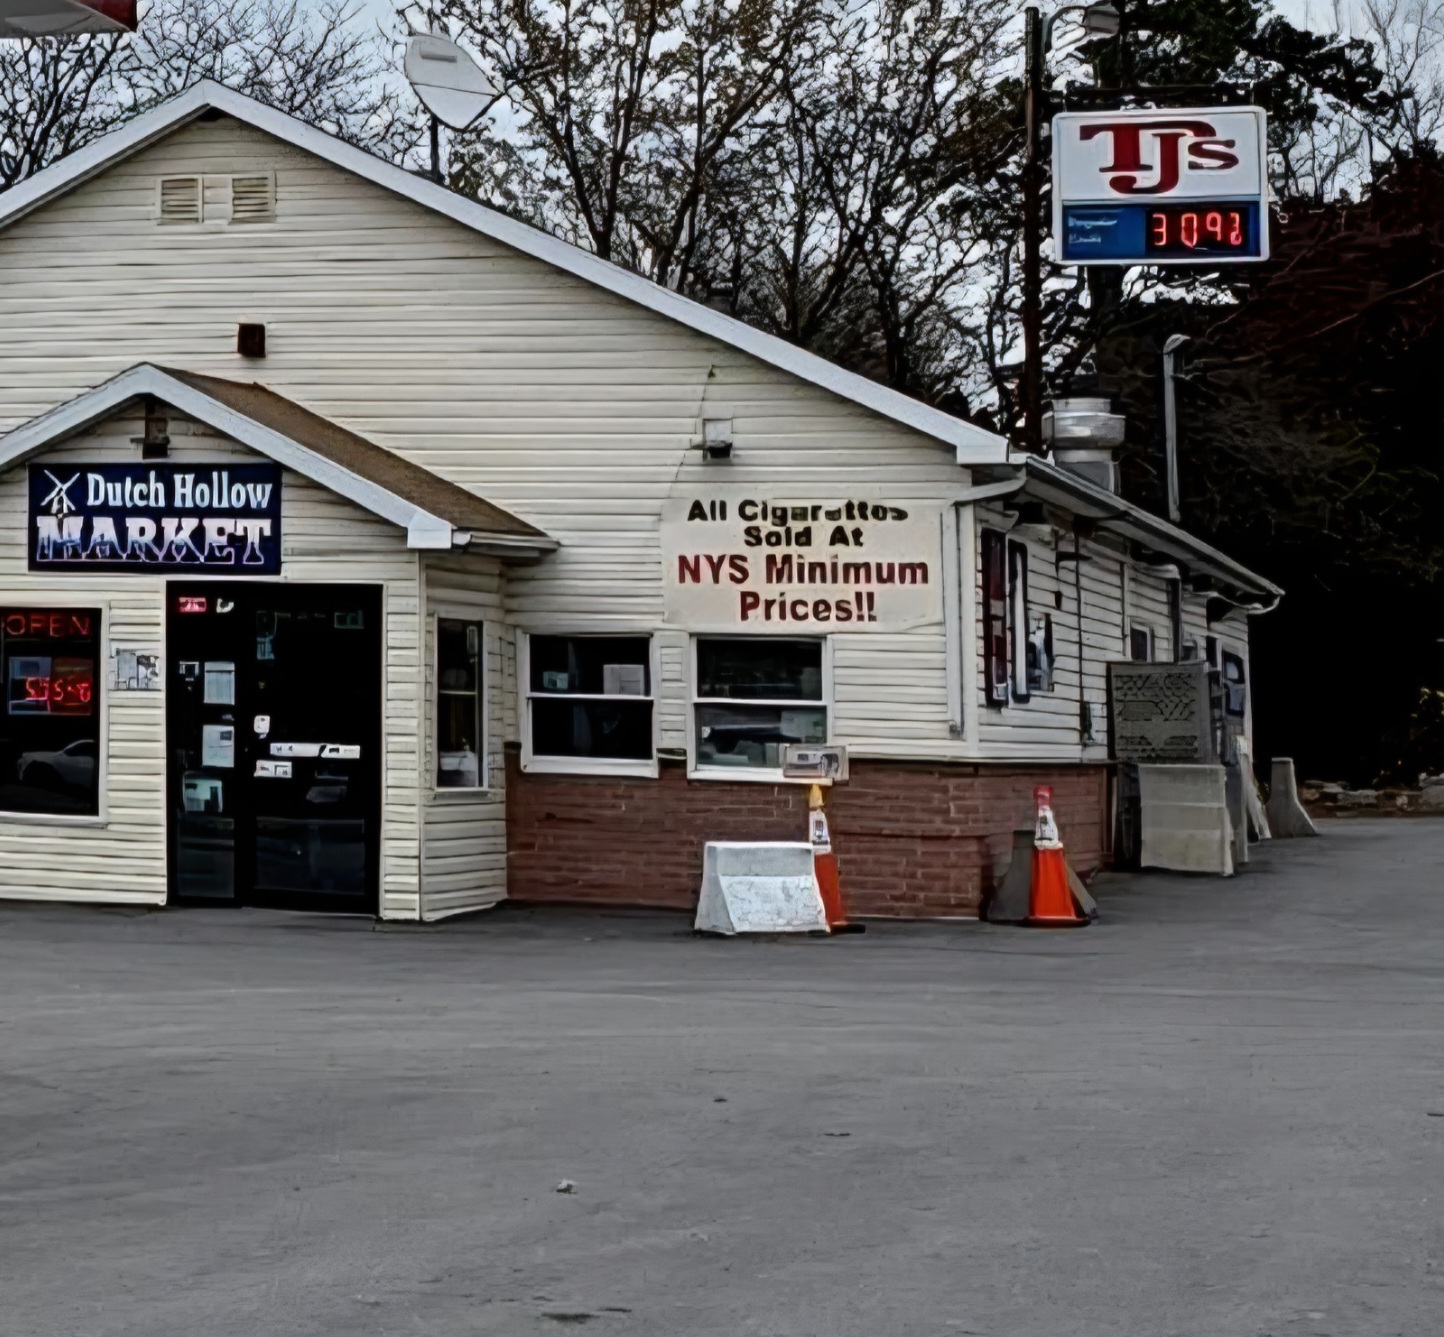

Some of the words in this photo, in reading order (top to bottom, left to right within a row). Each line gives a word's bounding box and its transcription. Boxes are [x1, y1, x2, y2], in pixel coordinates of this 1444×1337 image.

[87, 470, 165, 508] Dutch
[173, 471, 272, 509] Hollow
[687, 500, 727, 521] All
[36, 516, 272, 564] MARKET
[744, 525, 812, 547] Sold
[829, 525, 864, 547] At
[678, 554, 750, 584] NYS
[765, 553, 929, 584] Minimum
[740, 591, 878, 622] Prices!!
[6, 614, 90, 637] OPEN
